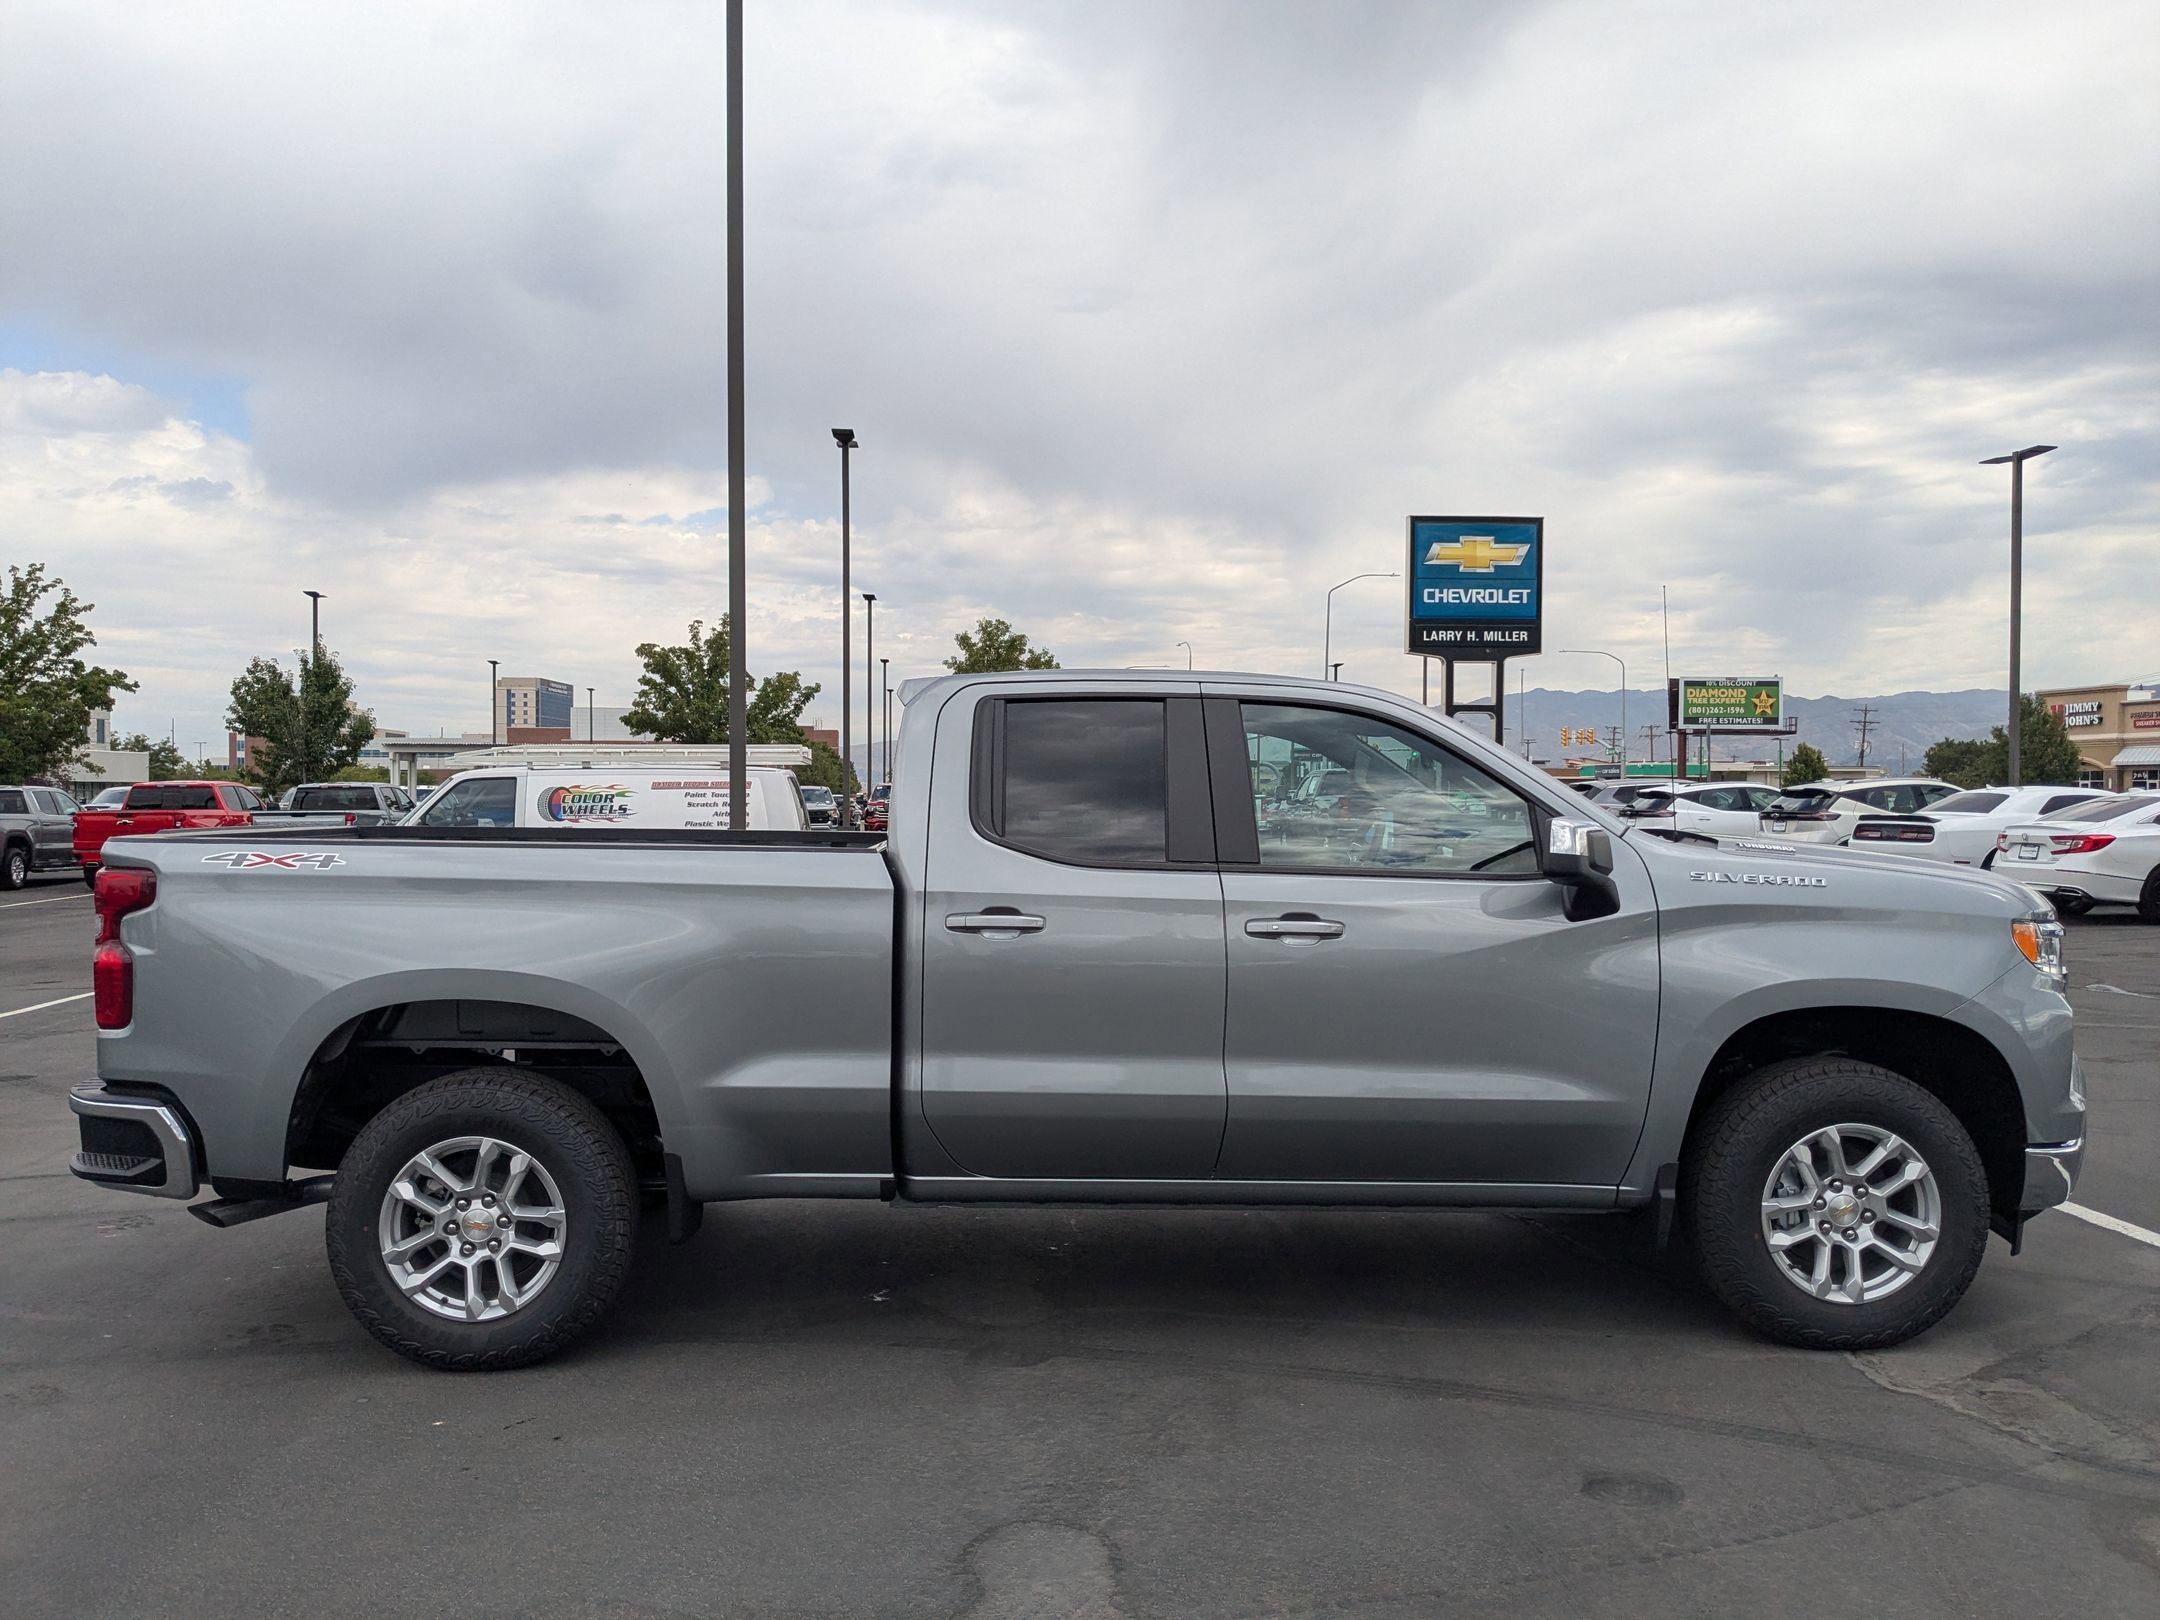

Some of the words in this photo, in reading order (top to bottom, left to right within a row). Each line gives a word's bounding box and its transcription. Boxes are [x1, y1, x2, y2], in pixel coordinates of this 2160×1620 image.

[1423, 588, 1531, 604] CHEVROLET
[1423, 630, 1462, 642] LARRY
[1467, 630, 1479, 642] H.
[1483, 630, 1528, 642] MILLER
[1686, 688, 1747, 698] DIAMOND
[1688, 706, 1745, 715] (801)262-1596
[2064, 701, 2099, 716] JIMMY
[2064, 714, 2100, 728] JOHN'S
[561, 793, 615, 804] COLOR
[562, 804, 629, 815] WHEELS
[1689, 871, 1828, 888] SILVERADO
